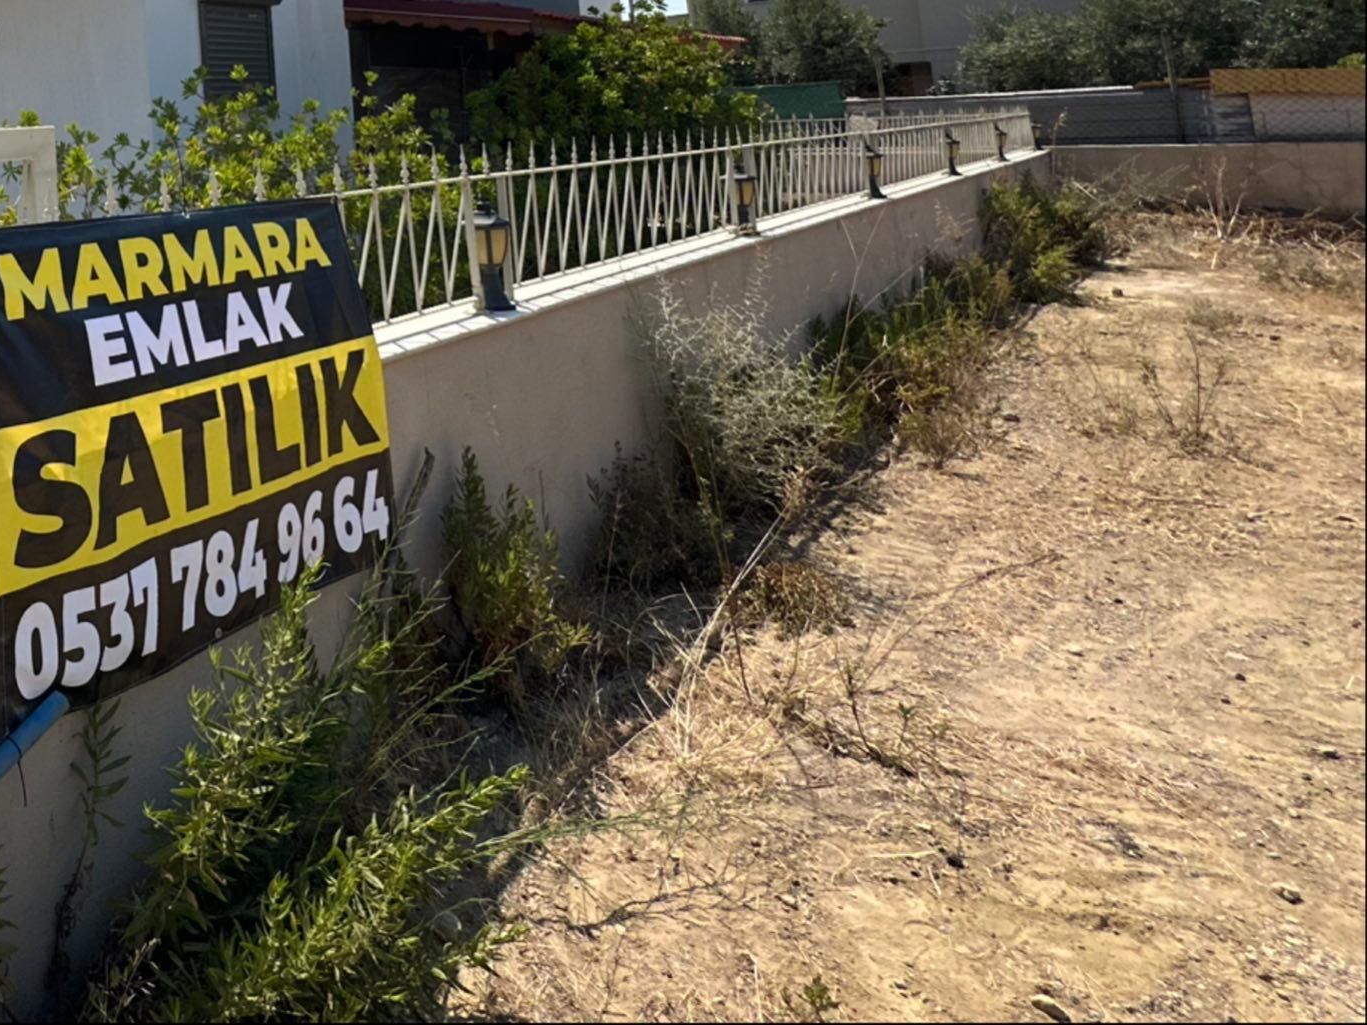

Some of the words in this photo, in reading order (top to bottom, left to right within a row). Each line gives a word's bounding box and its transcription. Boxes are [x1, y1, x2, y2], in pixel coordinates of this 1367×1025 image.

[84, 282, 304, 387] EMLAK
[11, 348, 381, 569] SATILIK
[14, 558, 159, 701] 0537
[170, 520, 267, 632] 784
[277, 490, 325, 583] 96
[334, 468, 390, 554] 64
